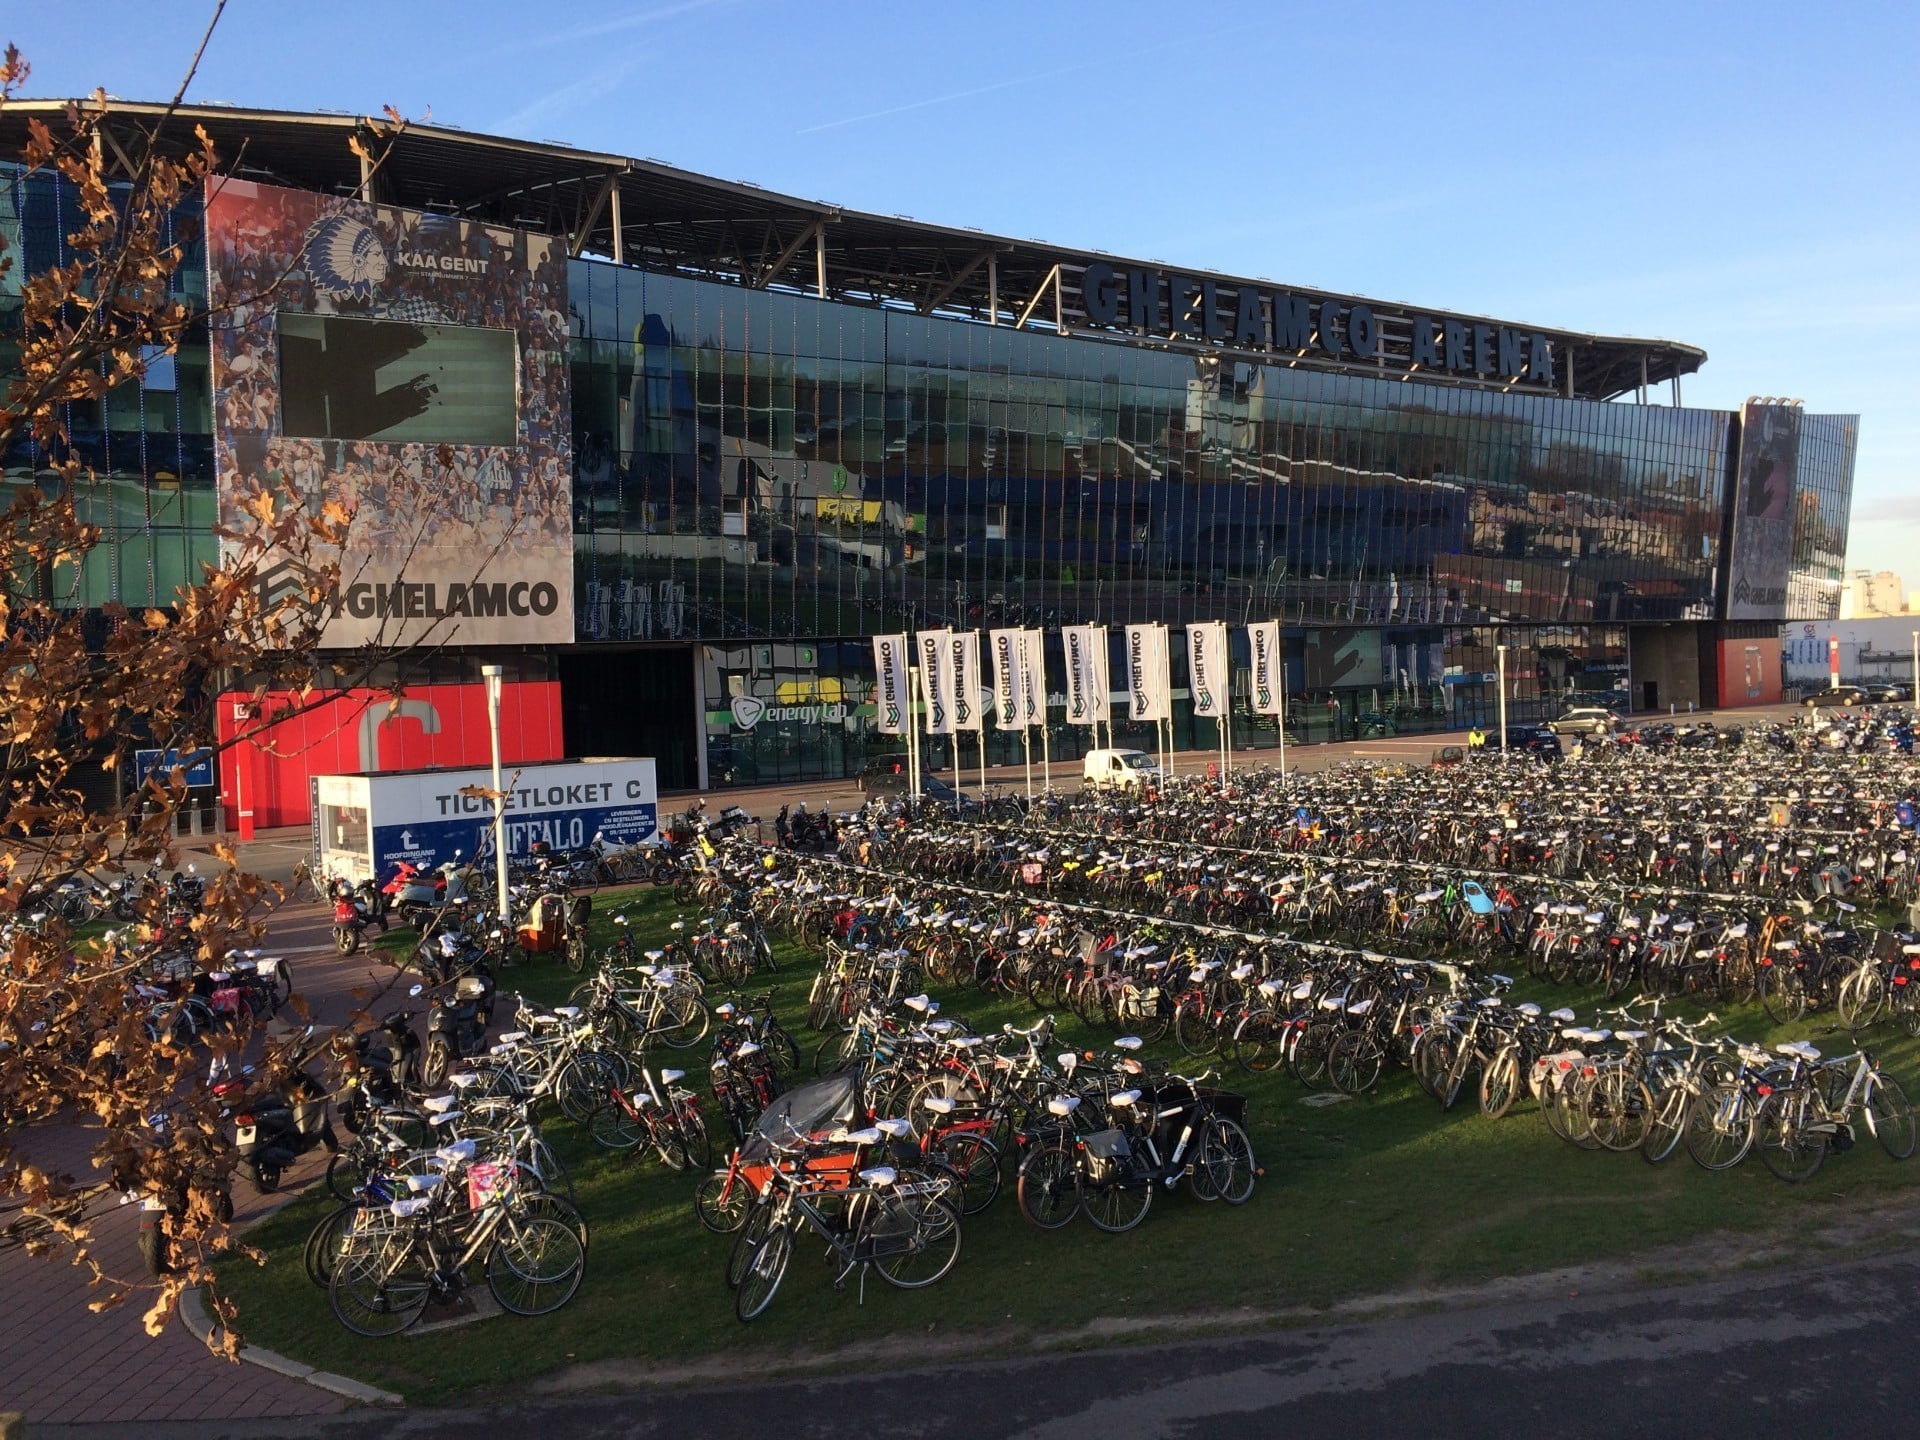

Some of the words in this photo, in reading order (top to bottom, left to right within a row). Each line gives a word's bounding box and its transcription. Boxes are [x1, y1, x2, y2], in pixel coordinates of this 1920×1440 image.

[398, 252, 437, 269] KAA
[440, 256, 489, 274] GENT
[1083, 263, 1378, 356] GHELAMCO
[1412, 315, 1553, 381] ARENA
[346, 581, 559, 619] GHELAMCO
[766, 706, 820, 725] energy
[823, 701, 847, 719] lab
[625, 780, 641, 799] C
[383, 849, 436, 860] HOOFDINGANG
